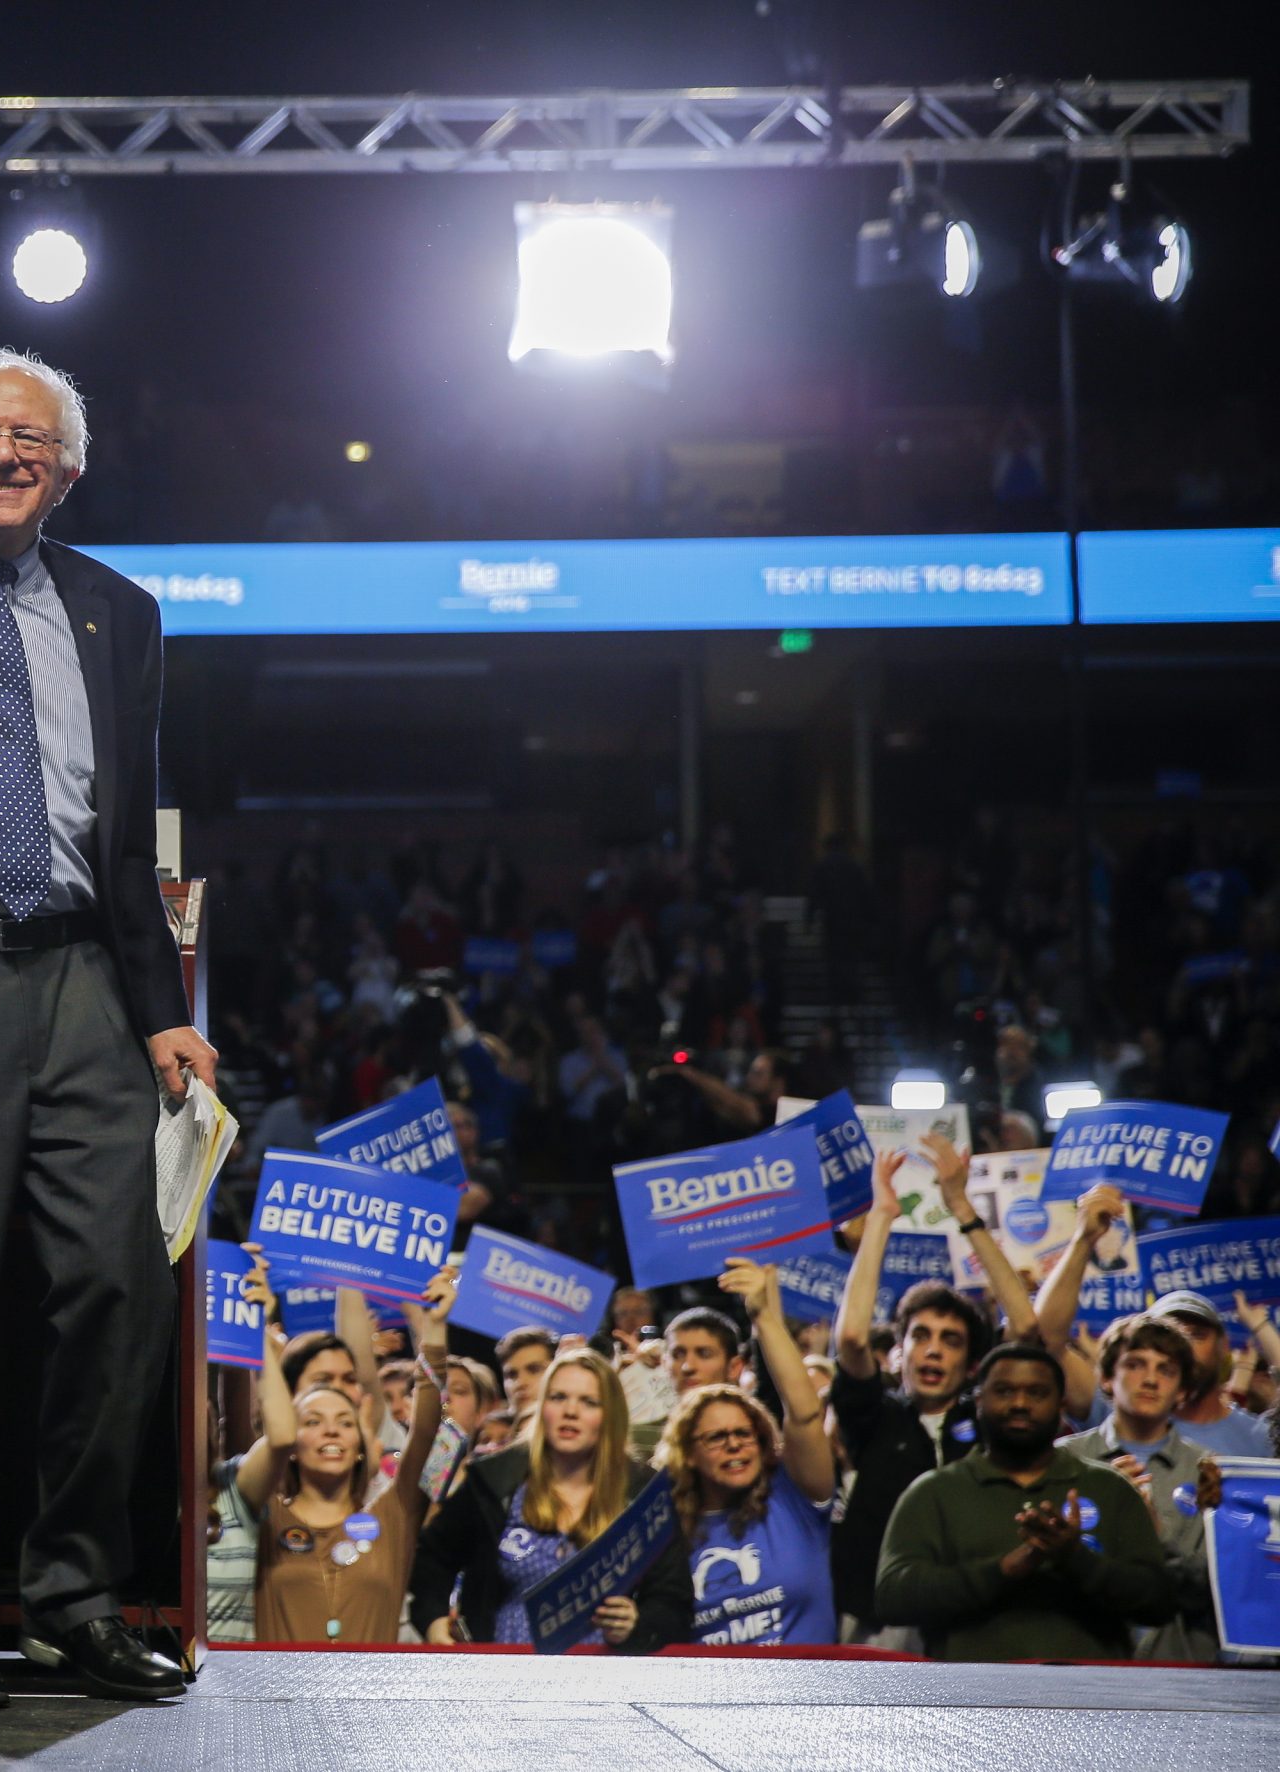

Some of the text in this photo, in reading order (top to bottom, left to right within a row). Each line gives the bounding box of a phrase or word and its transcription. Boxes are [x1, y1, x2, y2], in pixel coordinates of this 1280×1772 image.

[460, 557, 558, 594] Bernie
[762, 566, 826, 595] TEXT
[828, 565, 919, 594] BERNIE
[921, 564, 961, 592] TO
[349, 1108, 447, 1164] FUTURE TO
[431, 1131, 456, 1162] IN
[831, 1119, 862, 1147] TO
[1059, 1123, 1214, 1158] A FUTURE TO
[842, 1142, 872, 1174] IN
[1051, 1143, 1208, 1182] BELIEVE IN
[646, 1154, 797, 1215] Bernie
[265, 1180, 448, 1237] A FUTURE TO
[259, 1205, 445, 1267] BELIEVE IN
[1150, 1252, 1170, 1273] A
[1168, 1240, 1254, 1268] FUTURE
[483, 1247, 592, 1313] Bernie
[1153, 1259, 1263, 1294] BELIEVE
[222, 1298, 261, 1330] IN
[1115, 1288, 1143, 1311] IN
[538, 1490, 667, 1620] A FUTURE TO
[539, 1505, 669, 1638] BELIEVE IN
[691, 1606, 722, 1628] ALK
[729, 1607, 782, 1645] ME!
